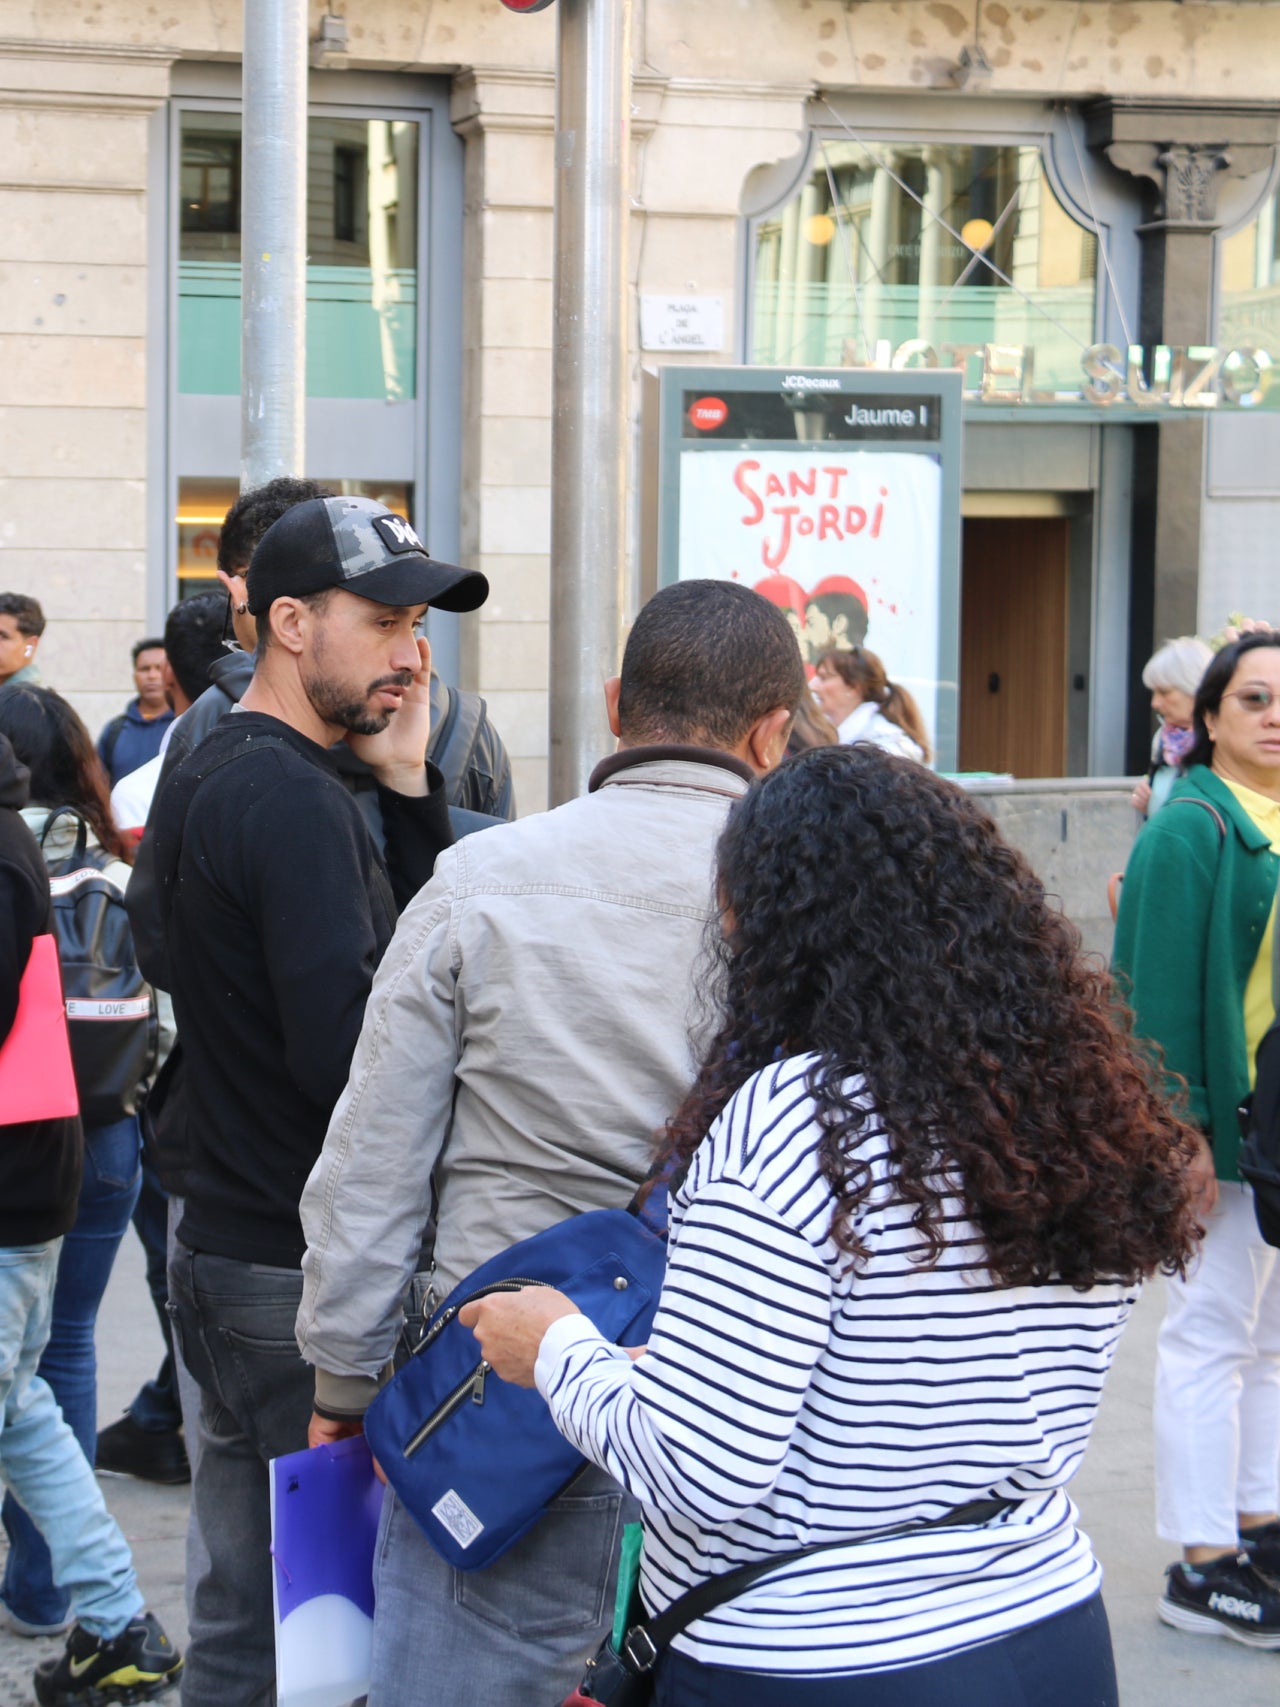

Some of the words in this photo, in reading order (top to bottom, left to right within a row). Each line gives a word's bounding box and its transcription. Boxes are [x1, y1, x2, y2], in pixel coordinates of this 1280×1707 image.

[676, 319, 688, 328] DE
[782, 376, 841, 389] JCDecaux
[1081, 343, 1273, 408] SUIZO
[696, 407, 724, 420] TMB
[845, 405, 915, 426] Jaume
[733, 459, 848, 526] SANT
[98, 1003, 126, 1015] LOVE
[1208, 1591, 1262, 1623] HOKA
